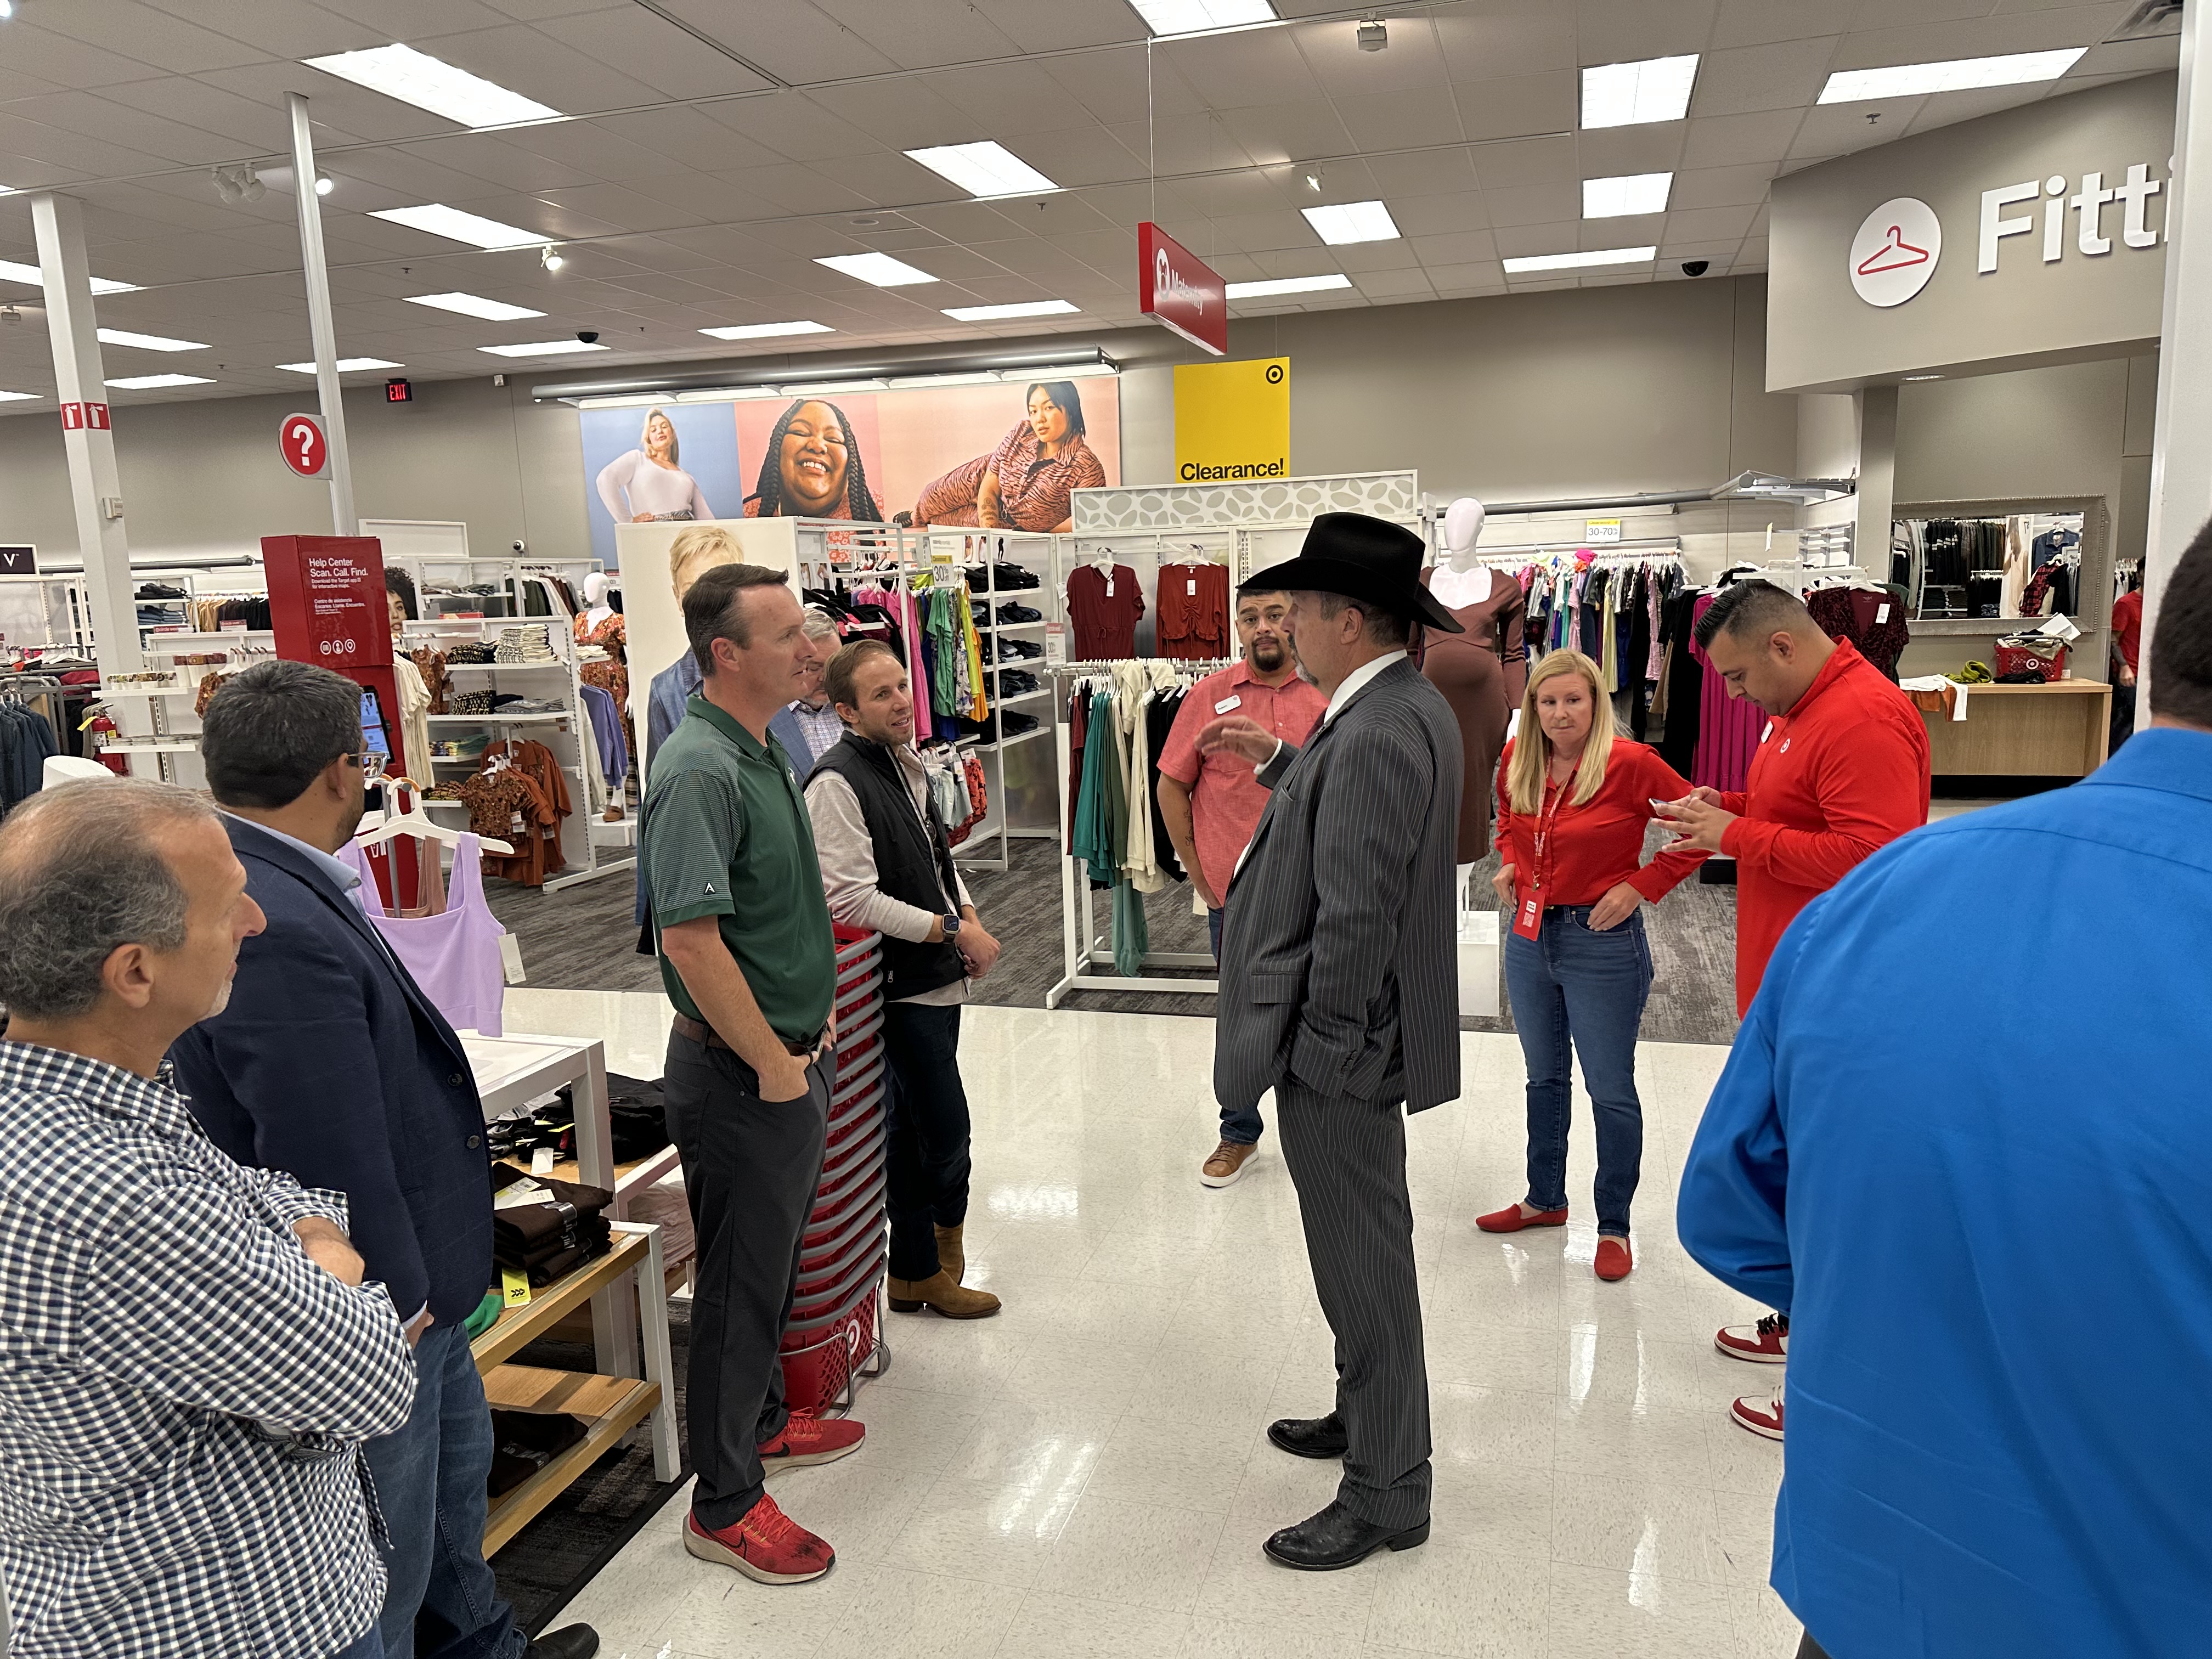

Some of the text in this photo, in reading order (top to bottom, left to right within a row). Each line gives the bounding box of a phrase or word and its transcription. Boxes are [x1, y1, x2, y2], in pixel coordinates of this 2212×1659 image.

[1978, 155, 2174, 273] Fitt
[1172, 269, 1203, 315] Maternity
[390, 385, 406, 400] EXIT
[1181, 458, 1284, 481] Clearance!
[309, 557, 353, 568] Help Center
[310, 567, 369, 577] Scan. Call. Find.
